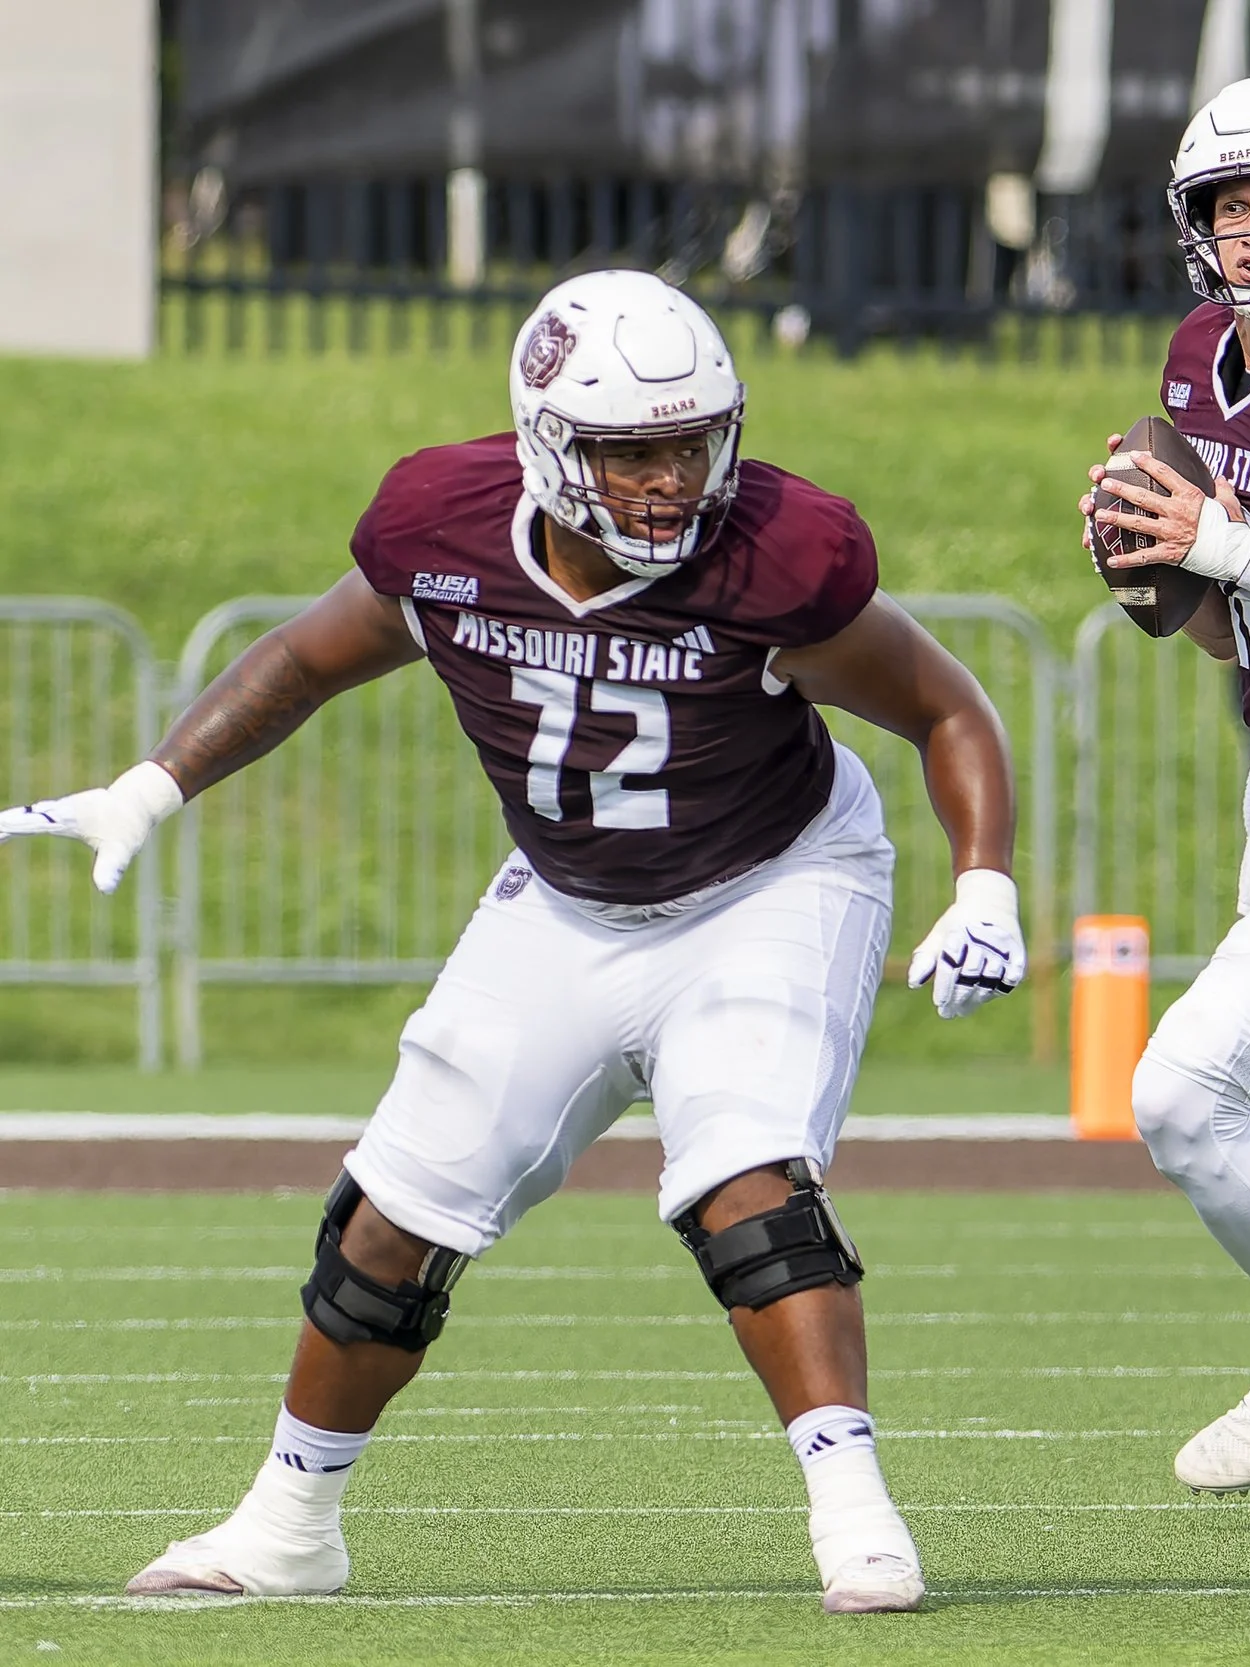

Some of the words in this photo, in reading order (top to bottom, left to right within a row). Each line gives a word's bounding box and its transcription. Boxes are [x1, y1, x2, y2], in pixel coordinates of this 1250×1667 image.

[650, 398, 697, 418] BEARS
[412, 588, 479, 605] GRADUATE
[452, 611, 597, 678] MISSOURI
[606, 636, 703, 681] STATE
[509, 665, 671, 830] 72
